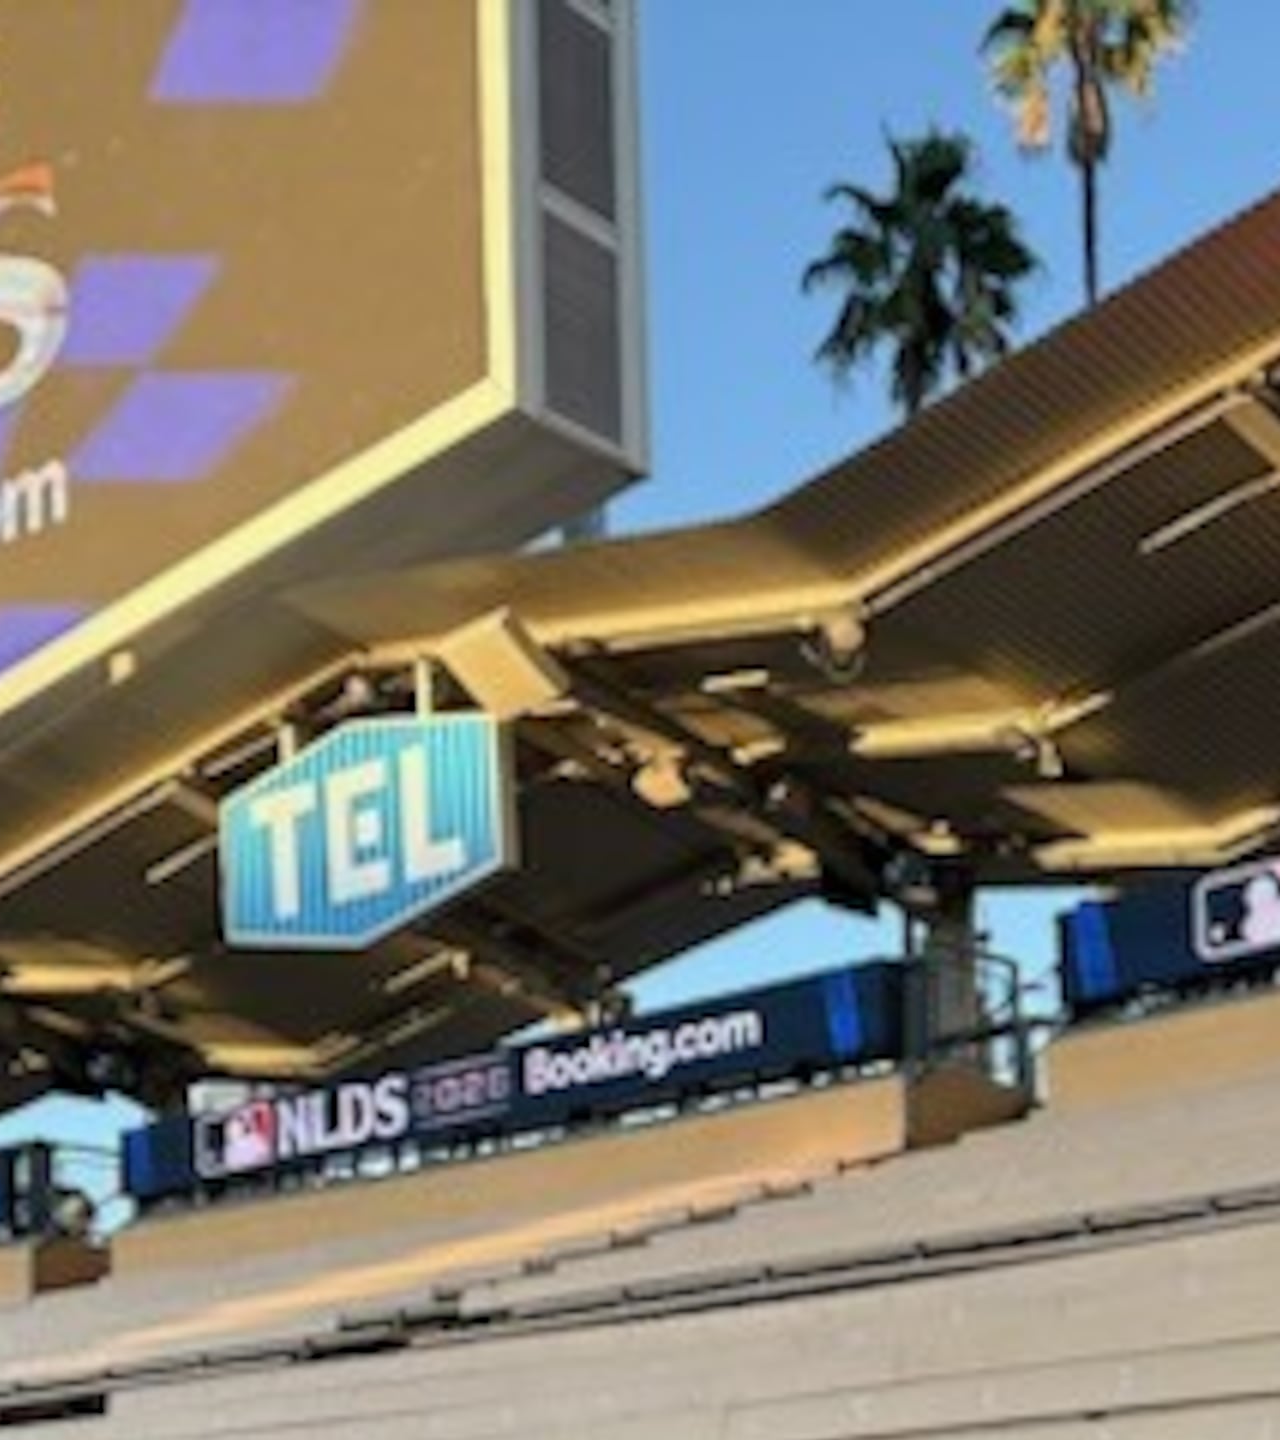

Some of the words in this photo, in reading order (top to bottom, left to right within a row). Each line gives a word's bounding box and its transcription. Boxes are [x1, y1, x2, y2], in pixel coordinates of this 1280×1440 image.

[251, 743, 467, 920] TEL
[274, 1074, 410, 1157] NLDS
[524, 1008, 762, 1095] Booking.com
